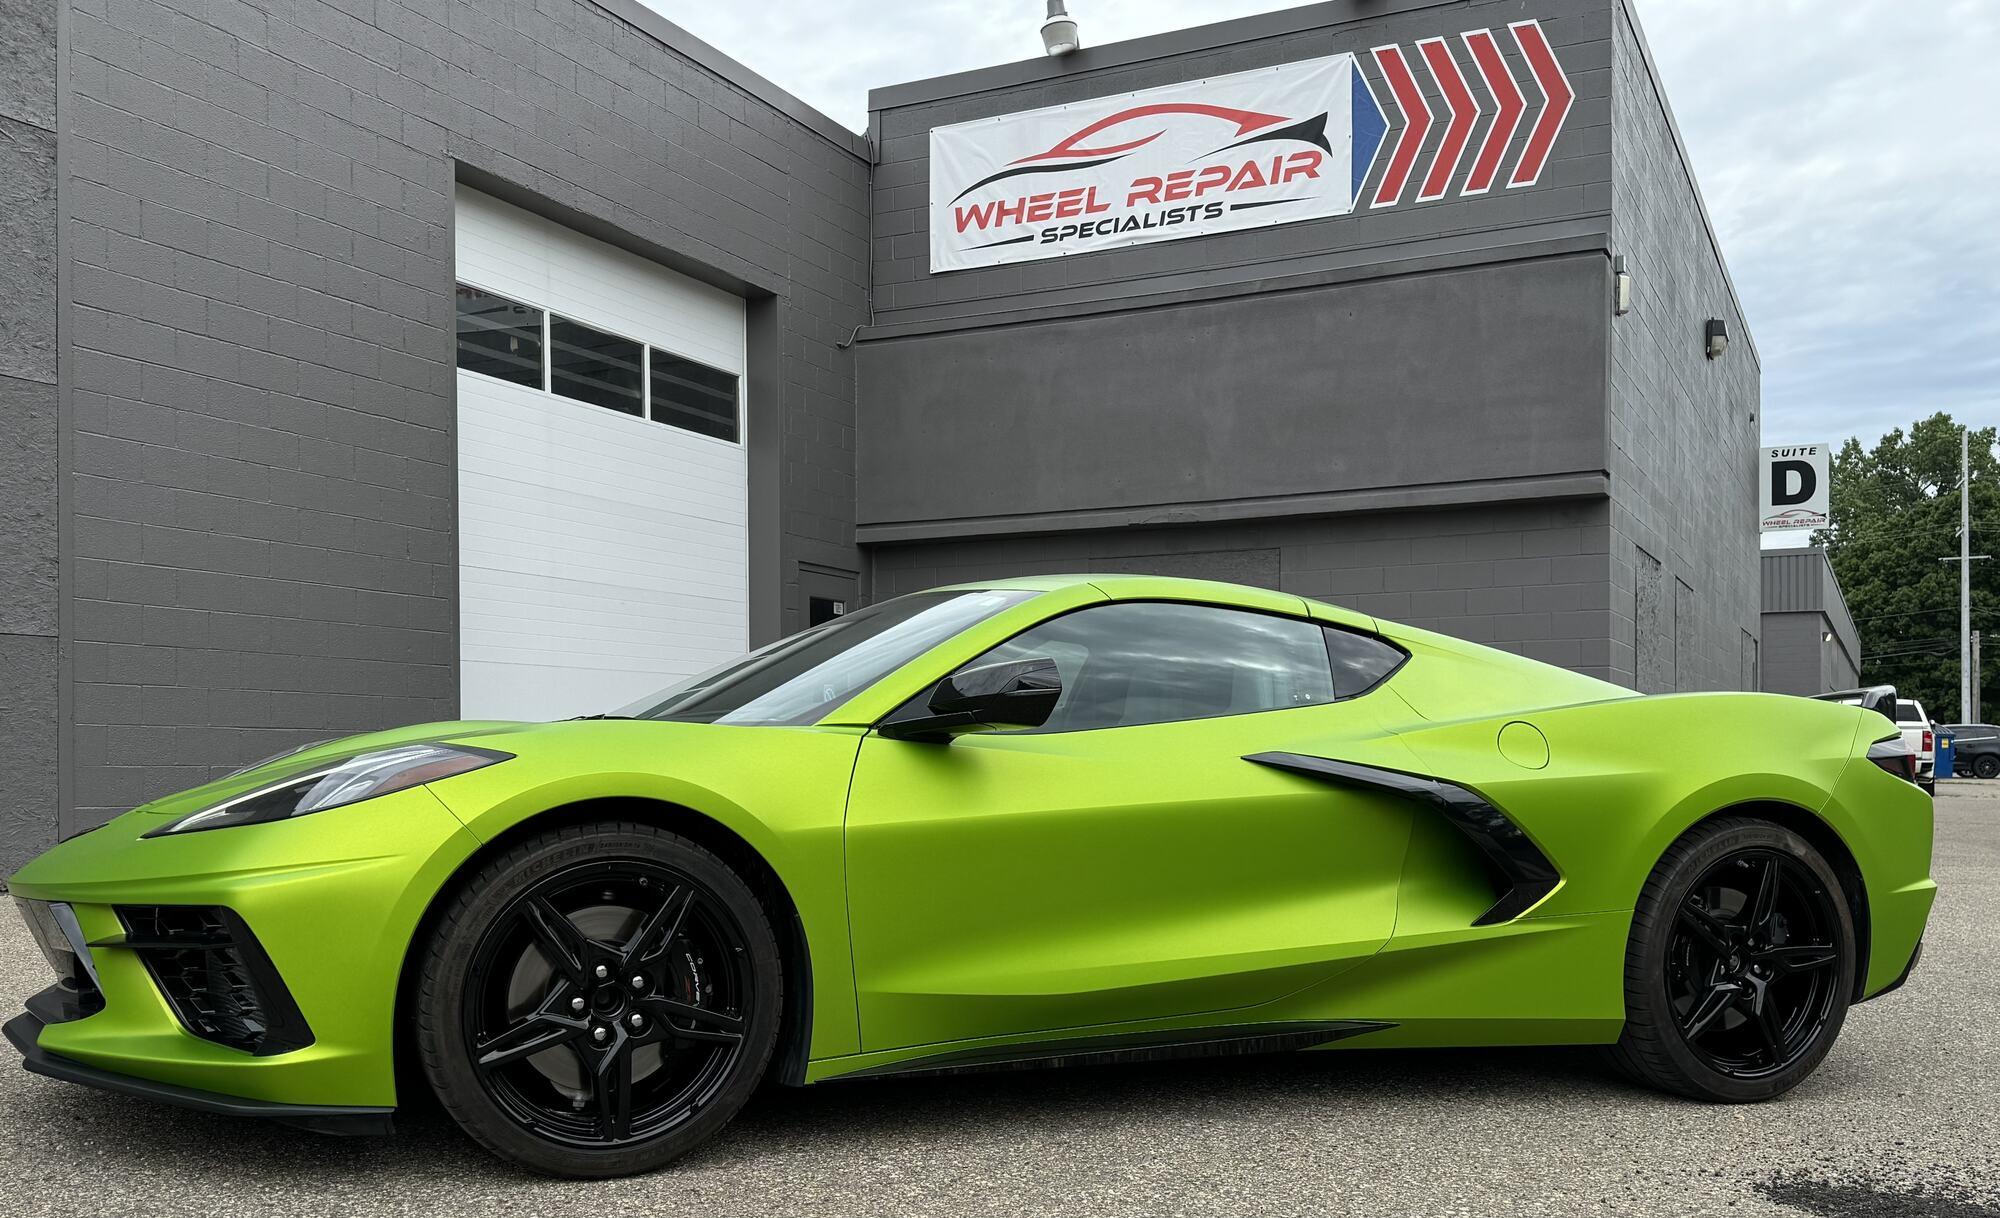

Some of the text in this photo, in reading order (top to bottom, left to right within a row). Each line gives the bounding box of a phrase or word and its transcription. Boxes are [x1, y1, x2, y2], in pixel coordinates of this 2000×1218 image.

[955, 150, 1323, 233] WHEEL REPAIR
[1040, 202, 1223, 244] SPECIALISTS
[1771, 447, 1817, 458] SUITE
[1771, 460, 1817, 507] D
[1793, 517, 1826, 525] REPAIR
